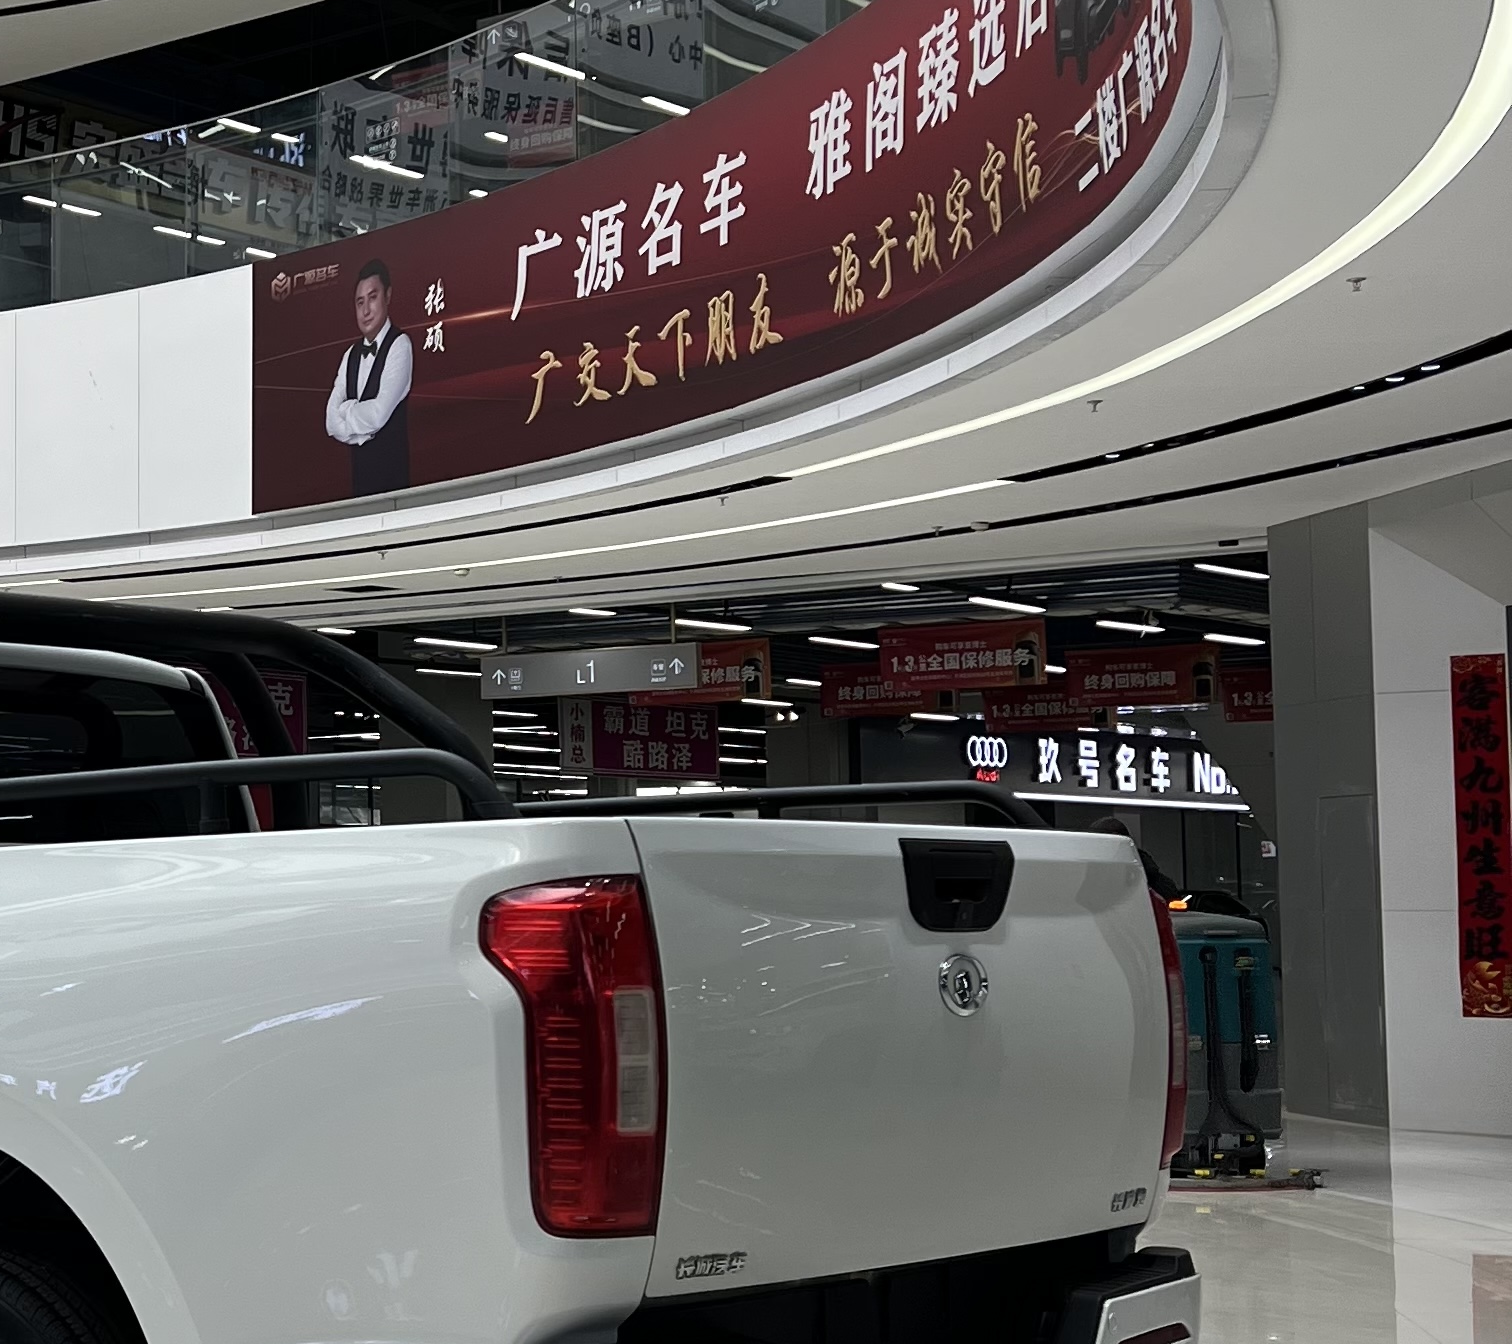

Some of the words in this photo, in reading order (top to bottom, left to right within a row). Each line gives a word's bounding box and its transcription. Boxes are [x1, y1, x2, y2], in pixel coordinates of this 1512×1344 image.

[510, 151, 747, 321] 广源名车
[828, 111, 1043, 318] 源于诚实守信
[422, 277, 447, 353] 张硕
[525, 272, 784, 425] 广交天下朋友
[576, 659, 596, 685] L1
[1083, 670, 1178, 690] 终身回购保障
[602, 706, 650, 736] 霸道
[665, 710, 710, 741] 坦克
[622, 740, 693, 771] 酷路泽
[1038, 737, 1171, 794] 玖号名车
